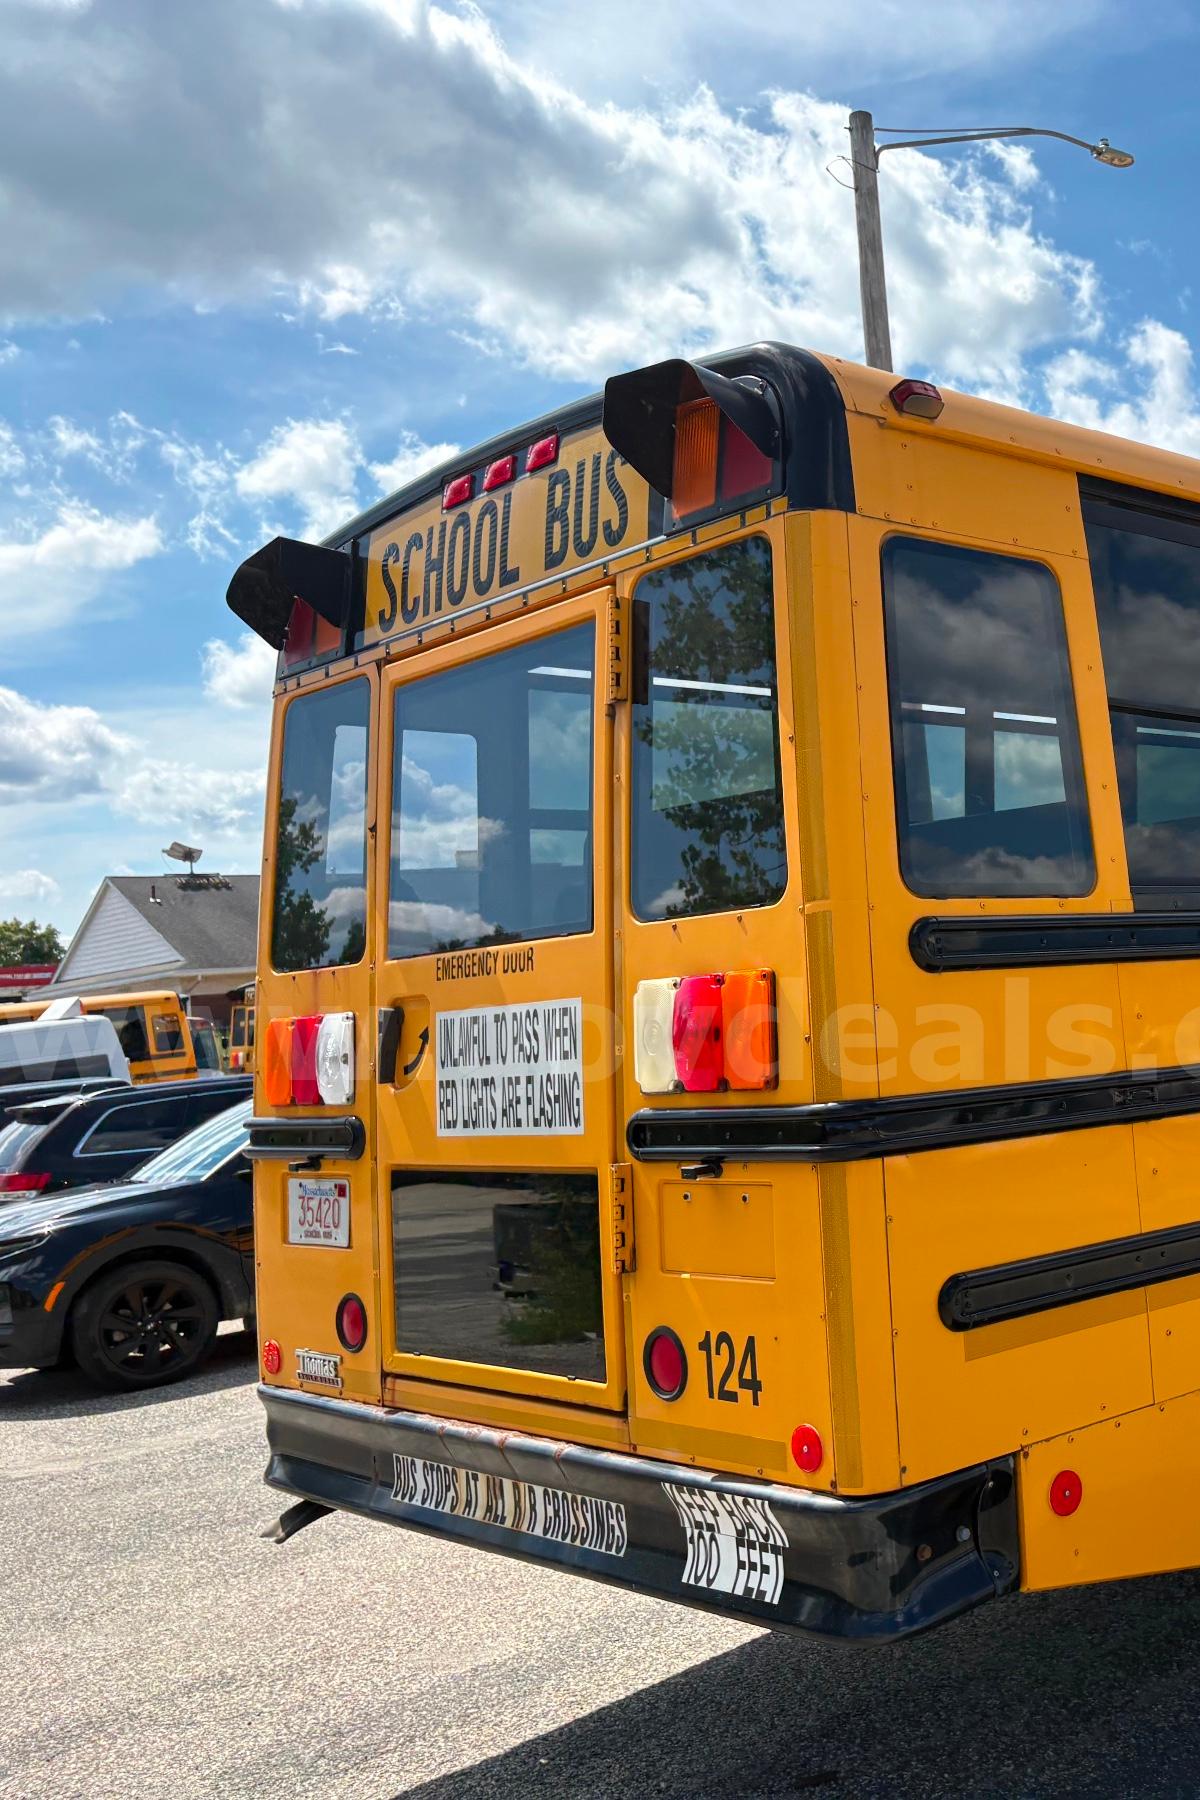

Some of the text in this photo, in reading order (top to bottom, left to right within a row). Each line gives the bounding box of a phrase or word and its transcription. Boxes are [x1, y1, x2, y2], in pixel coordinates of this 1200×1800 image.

[378, 449, 629, 633] SCHOOL BUS
[436, 947, 534, 981] EMERGENCY DOOR
[439, 1006, 578, 1069] UNLAWFUL TO PASS WHEN
[438, 1072, 581, 1130] RED LIGHTS ARE FLASHING
[298, 1195, 341, 1229] 35420
[295, 1348, 341, 1378] Thomas
[698, 1330, 763, 1407] 124
[393, 1454, 628, 1556] BUS STOPS AT ALL R/R CROSSINGS
[662, 1483, 788, 1546] KEEP BACK
[686, 1527, 783, 1603] 100 FEET
